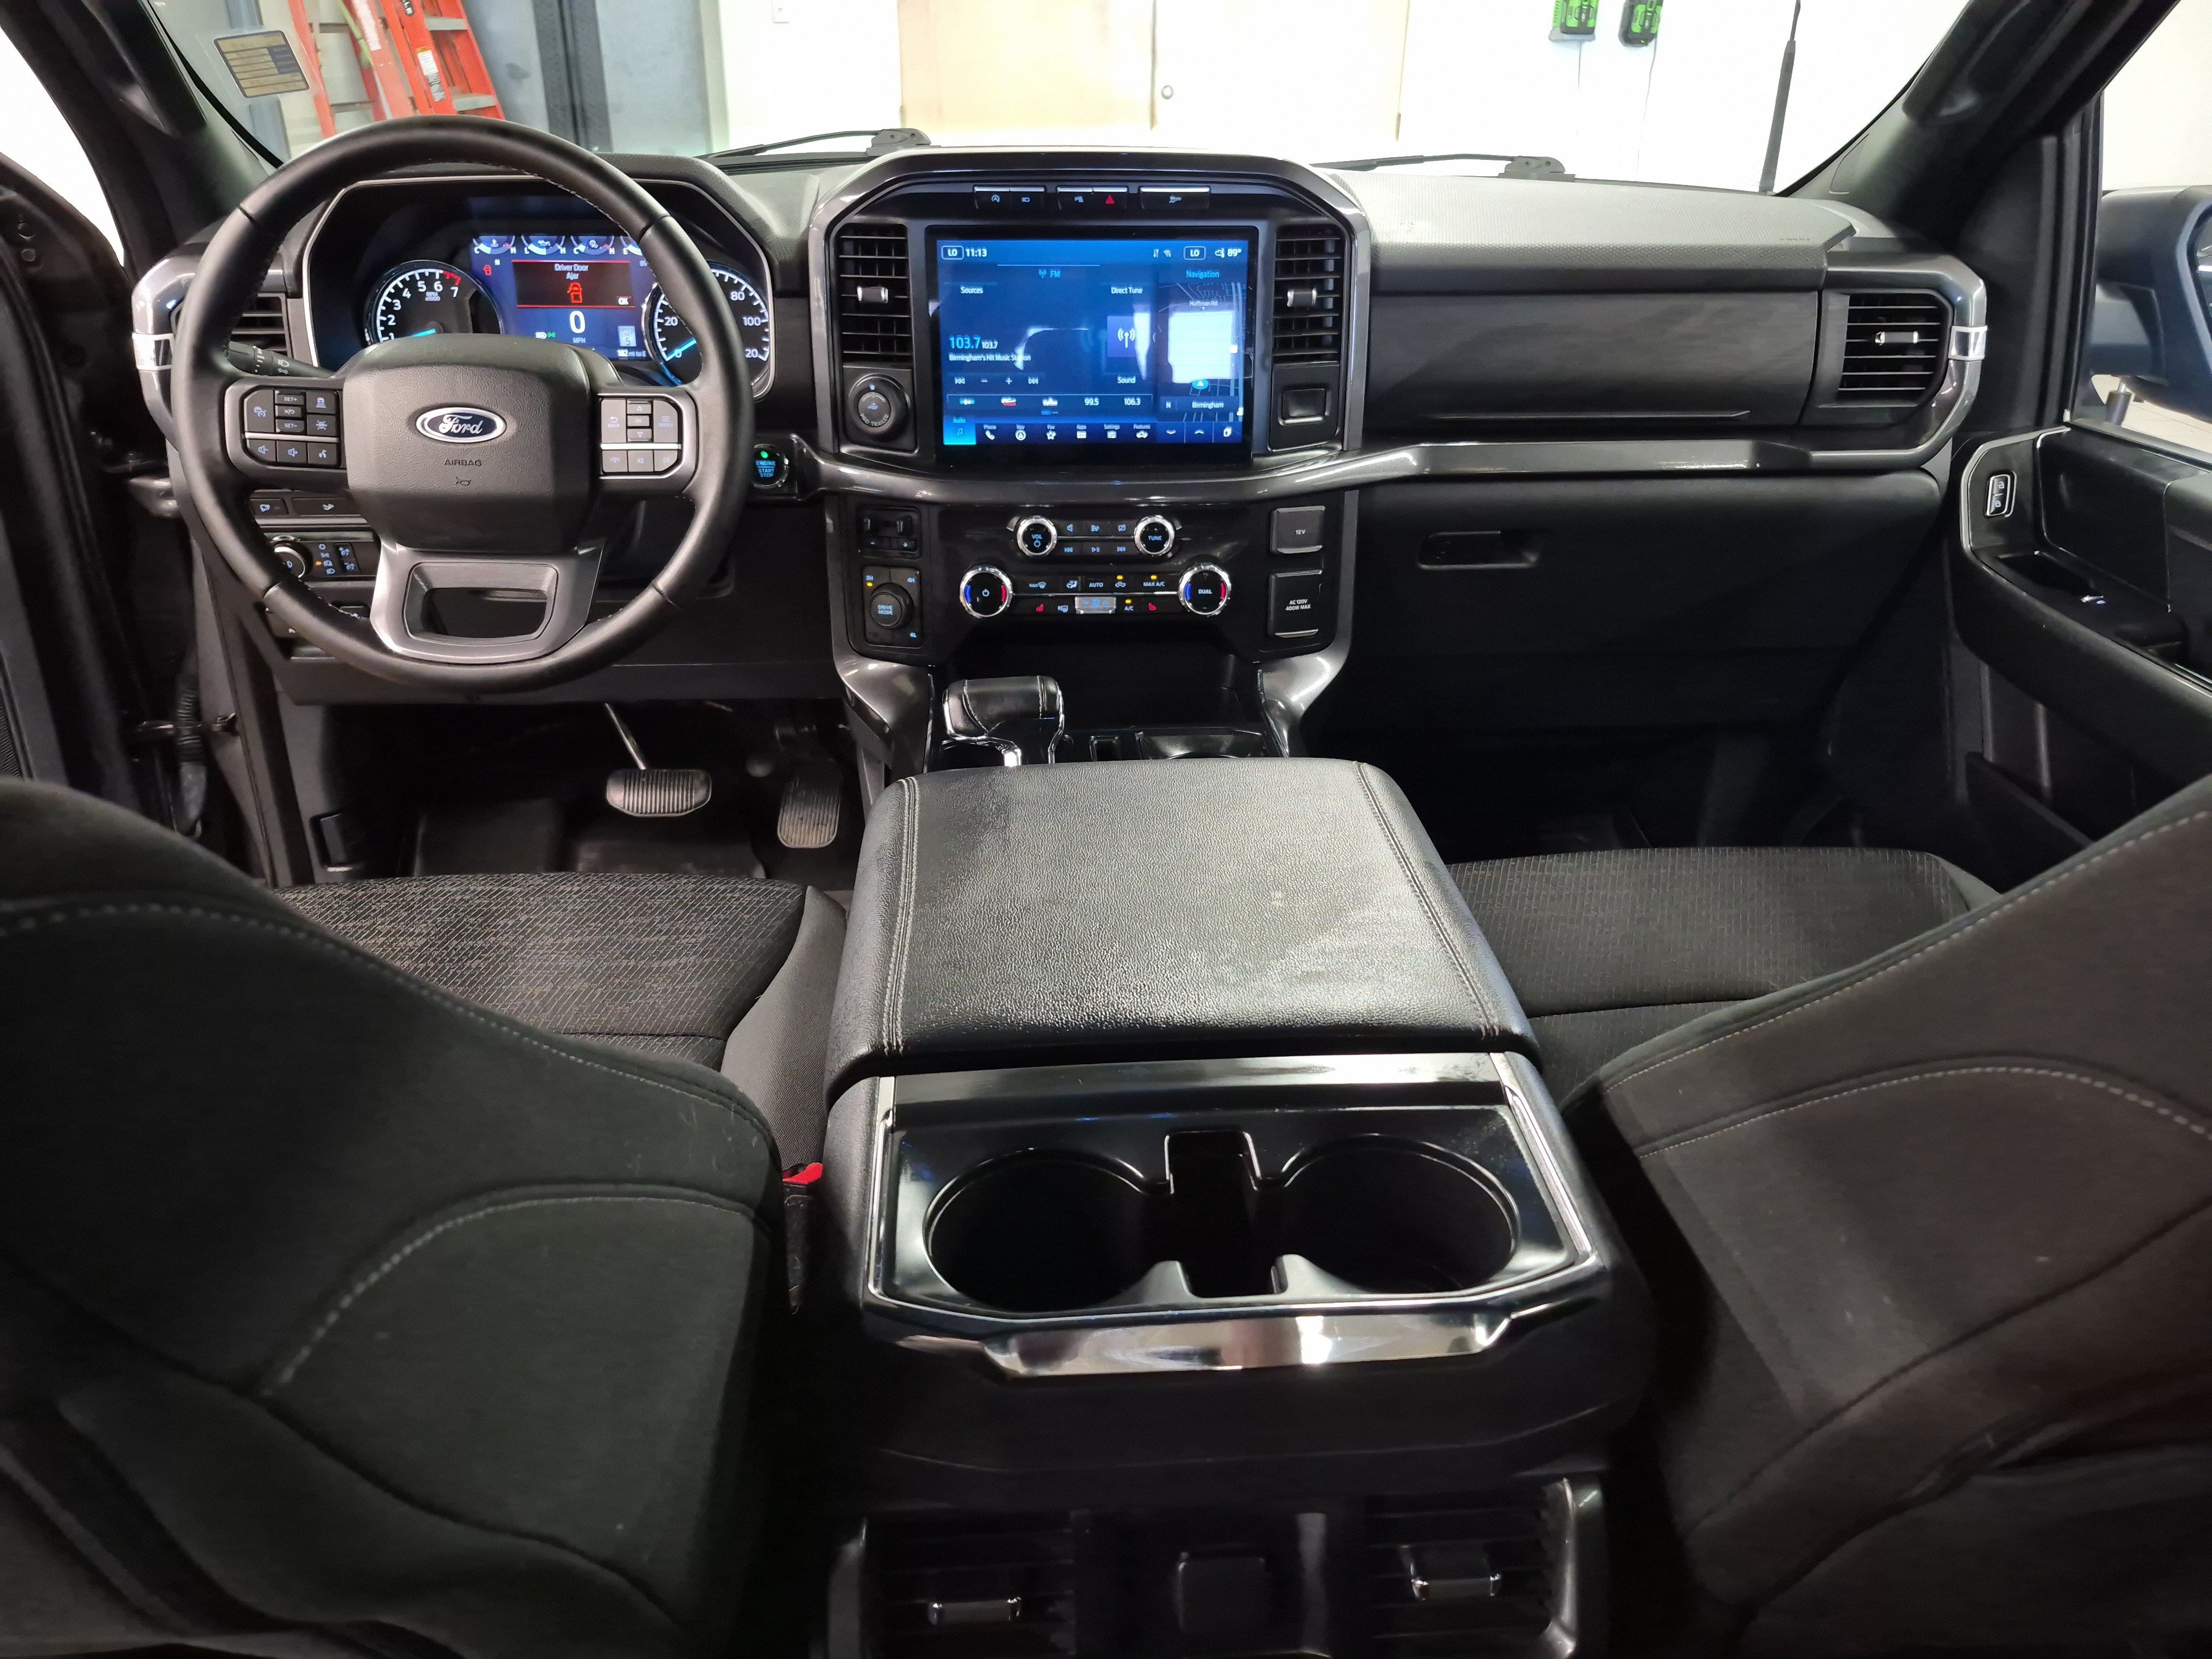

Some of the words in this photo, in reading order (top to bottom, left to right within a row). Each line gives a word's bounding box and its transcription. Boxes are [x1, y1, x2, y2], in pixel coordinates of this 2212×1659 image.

[948, 248, 958, 256] LO
[966, 248, 987, 257] 11:13
[1190, 249, 1200, 257] LO
[1186, 270, 1219, 279] Navigation
[417, 281, 427, 292] 5
[434, 281, 443, 292] 6
[402, 288, 411, 299] 4
[450, 286, 459, 298] 7
[730, 291, 745, 301] 80
[392, 299, 401, 311] 3
[387, 314, 396, 326] 2
[569, 311, 586, 334] 0
[664, 316, 678, 326] 20
[743, 316, 761, 326] 100
[388, 332, 395, 341] 1
[626, 337, 631, 346] 5
[950, 336, 981, 349] 103.7
[744, 348, 758, 358] 20
[949, 353, 986, 362] Birmingham's
[1084, 397, 1099, 406] 99.5
[1124, 397, 1141, 406] 106.3
[439, 414, 484, 434] Ford
